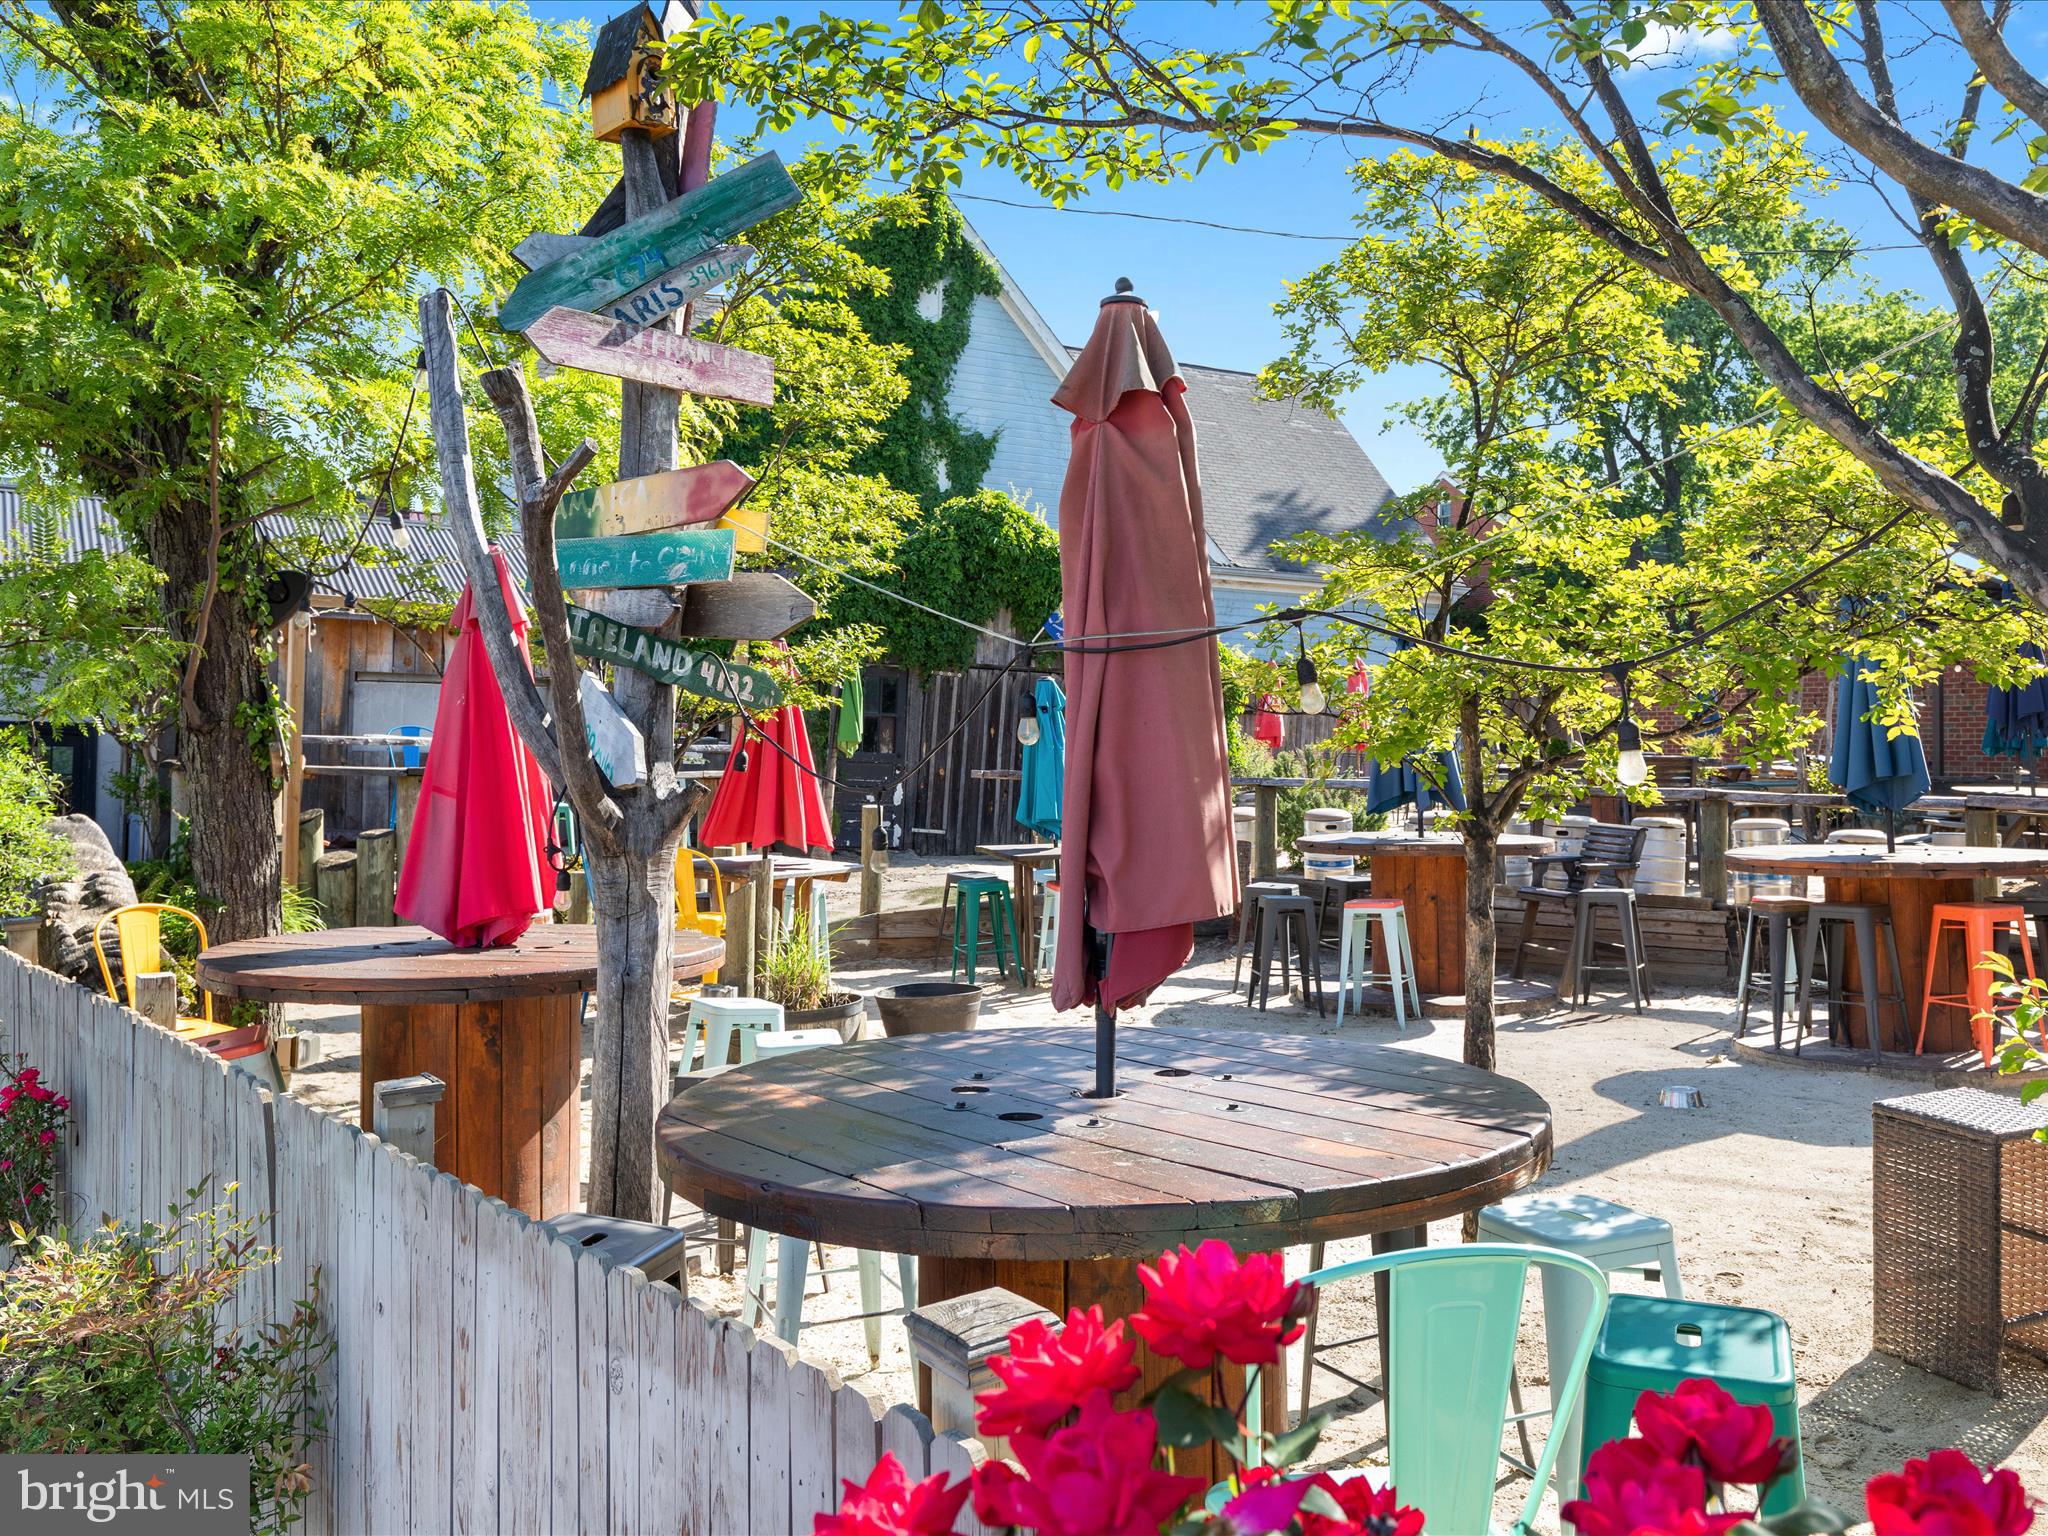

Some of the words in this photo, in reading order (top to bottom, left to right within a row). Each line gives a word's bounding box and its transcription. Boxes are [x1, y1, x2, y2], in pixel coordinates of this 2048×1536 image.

[613, 279, 684, 325] ARIS
[557, 479, 650, 519] AMAICA
[570, 607, 693, 677] IRELAND
